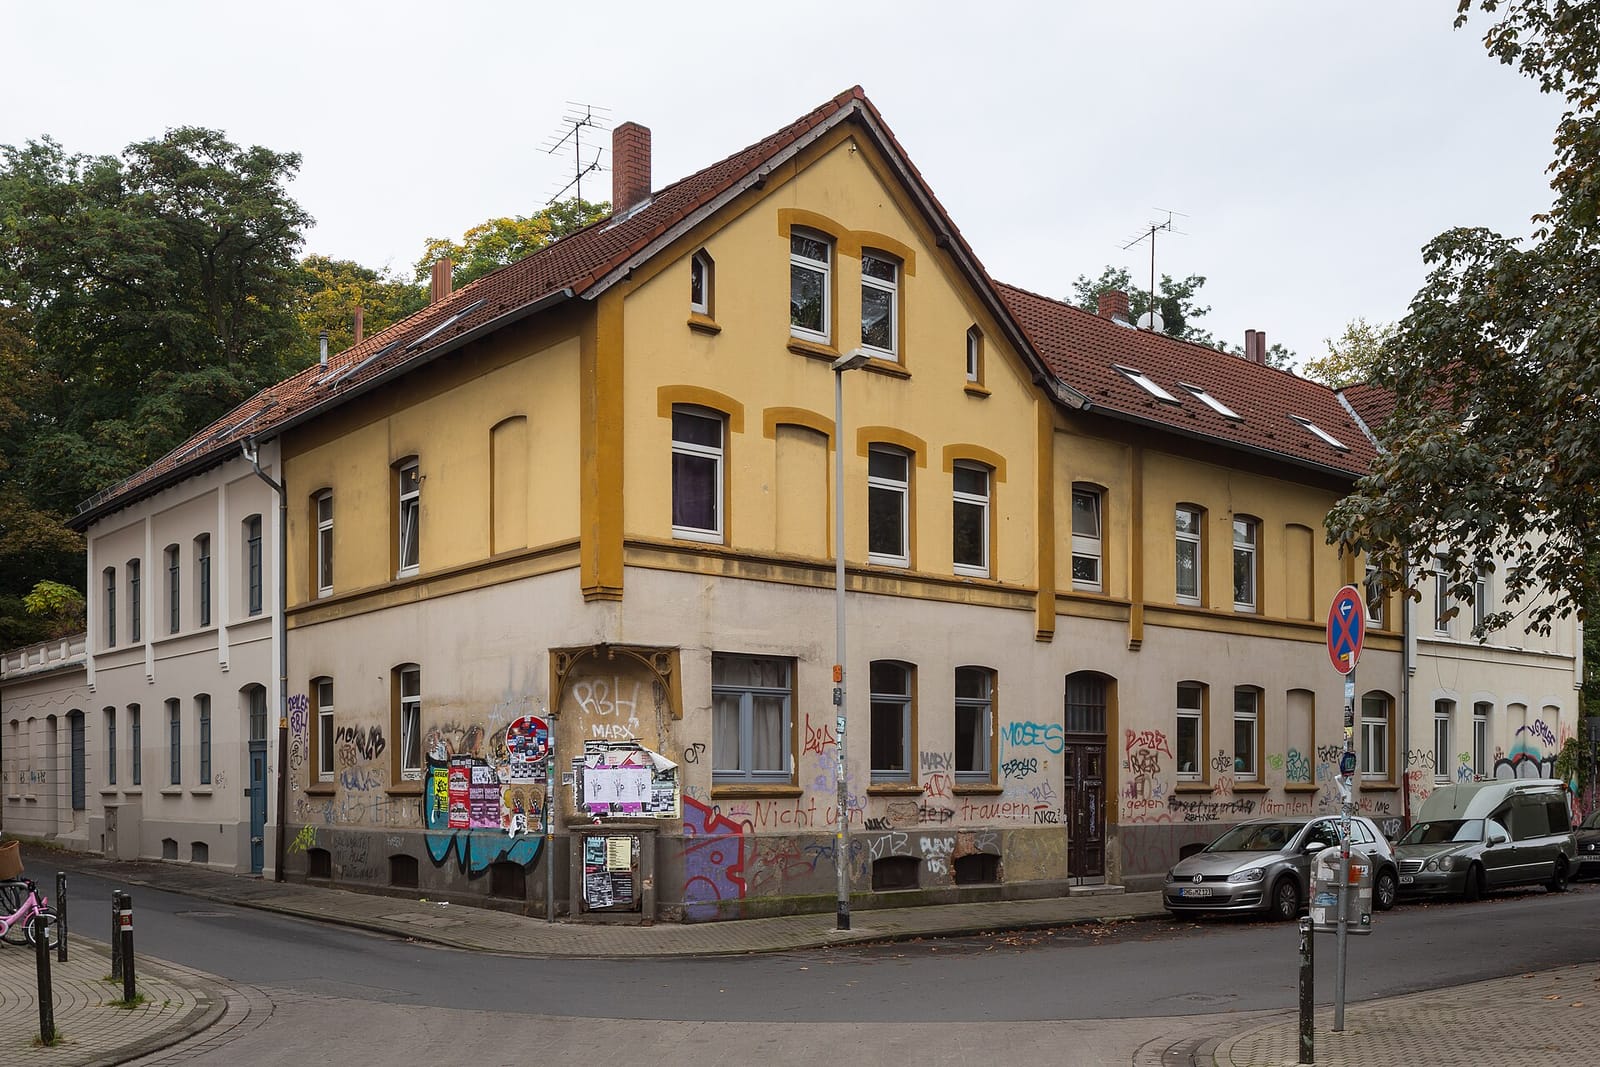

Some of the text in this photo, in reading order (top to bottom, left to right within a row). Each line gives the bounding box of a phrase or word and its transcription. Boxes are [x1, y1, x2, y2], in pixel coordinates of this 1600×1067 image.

[572, 677, 641, 717] RBH
[591, 723, 635, 739] MARX
[1001, 721, 1065, 754] MOSES
[753, 797, 816, 828] Nicht
[961, 798, 1031, 821] trauern
[1126, 799, 1164, 819] gegen
